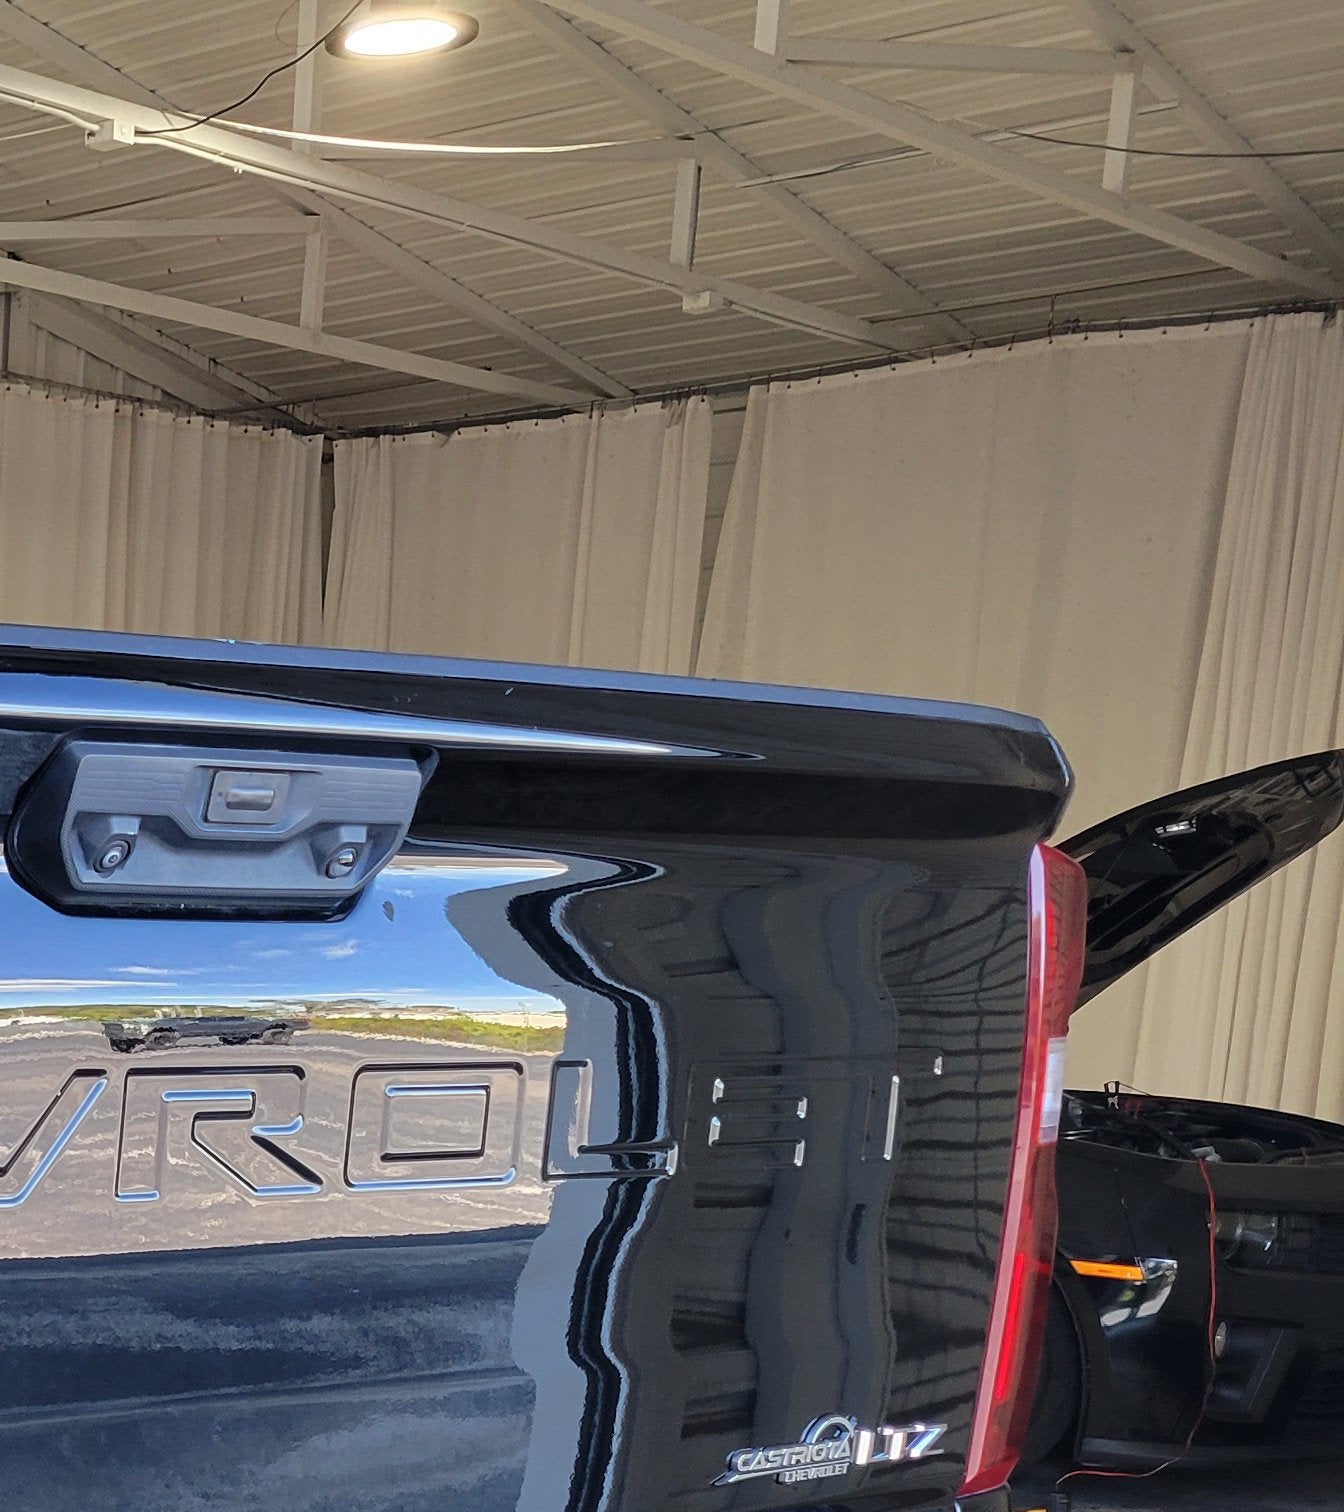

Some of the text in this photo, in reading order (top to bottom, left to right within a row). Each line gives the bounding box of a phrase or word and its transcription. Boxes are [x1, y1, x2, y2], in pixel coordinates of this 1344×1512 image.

[736, 1440, 851, 1473] CASTRIOTA
[853, 1423, 948, 1465] LTZ
[784, 1462, 849, 1484] CHEVROLET
